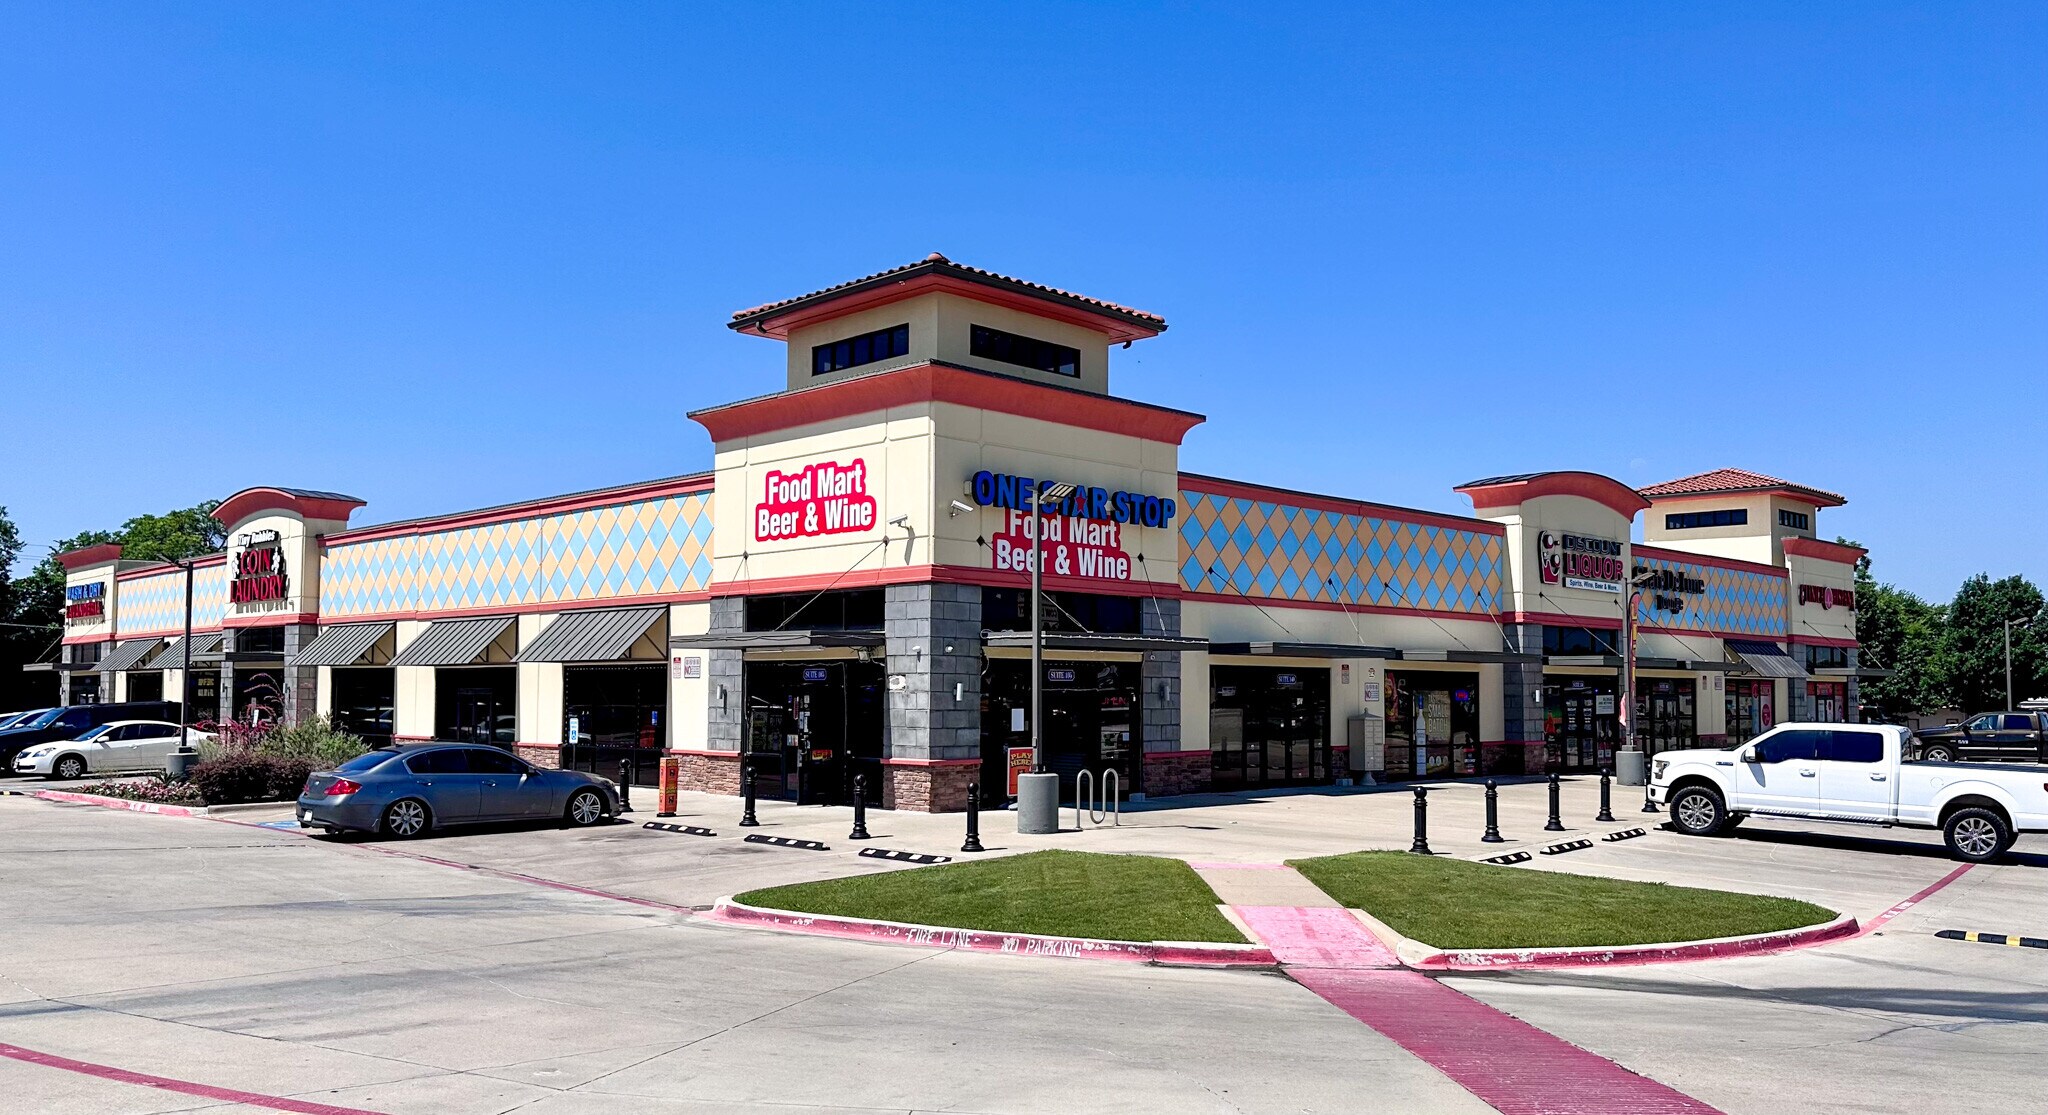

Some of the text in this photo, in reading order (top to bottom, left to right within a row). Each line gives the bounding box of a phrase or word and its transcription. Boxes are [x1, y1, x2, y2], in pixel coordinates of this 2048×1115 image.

[768, 464, 862, 505] Food Mart
[972, 470, 1034, 512] ONE
[1112, 491, 1176, 529] STOP
[758, 498, 872, 537] Beer & Wine
[1010, 508, 1117, 547] Food Mart
[1563, 534, 1622, 555] DISCOUNT
[241, 548, 271, 575] COIN
[997, 539, 1127, 580] Beer & Wine
[1565, 553, 1623, 580] LIQUOR
[230, 574, 284, 603] LAUNDRY
[1010, 752, 1032, 760] PLAY
[907, 928, 974, 948] FIRE LANE
[1024, 938, 1082, 958] PARKING
